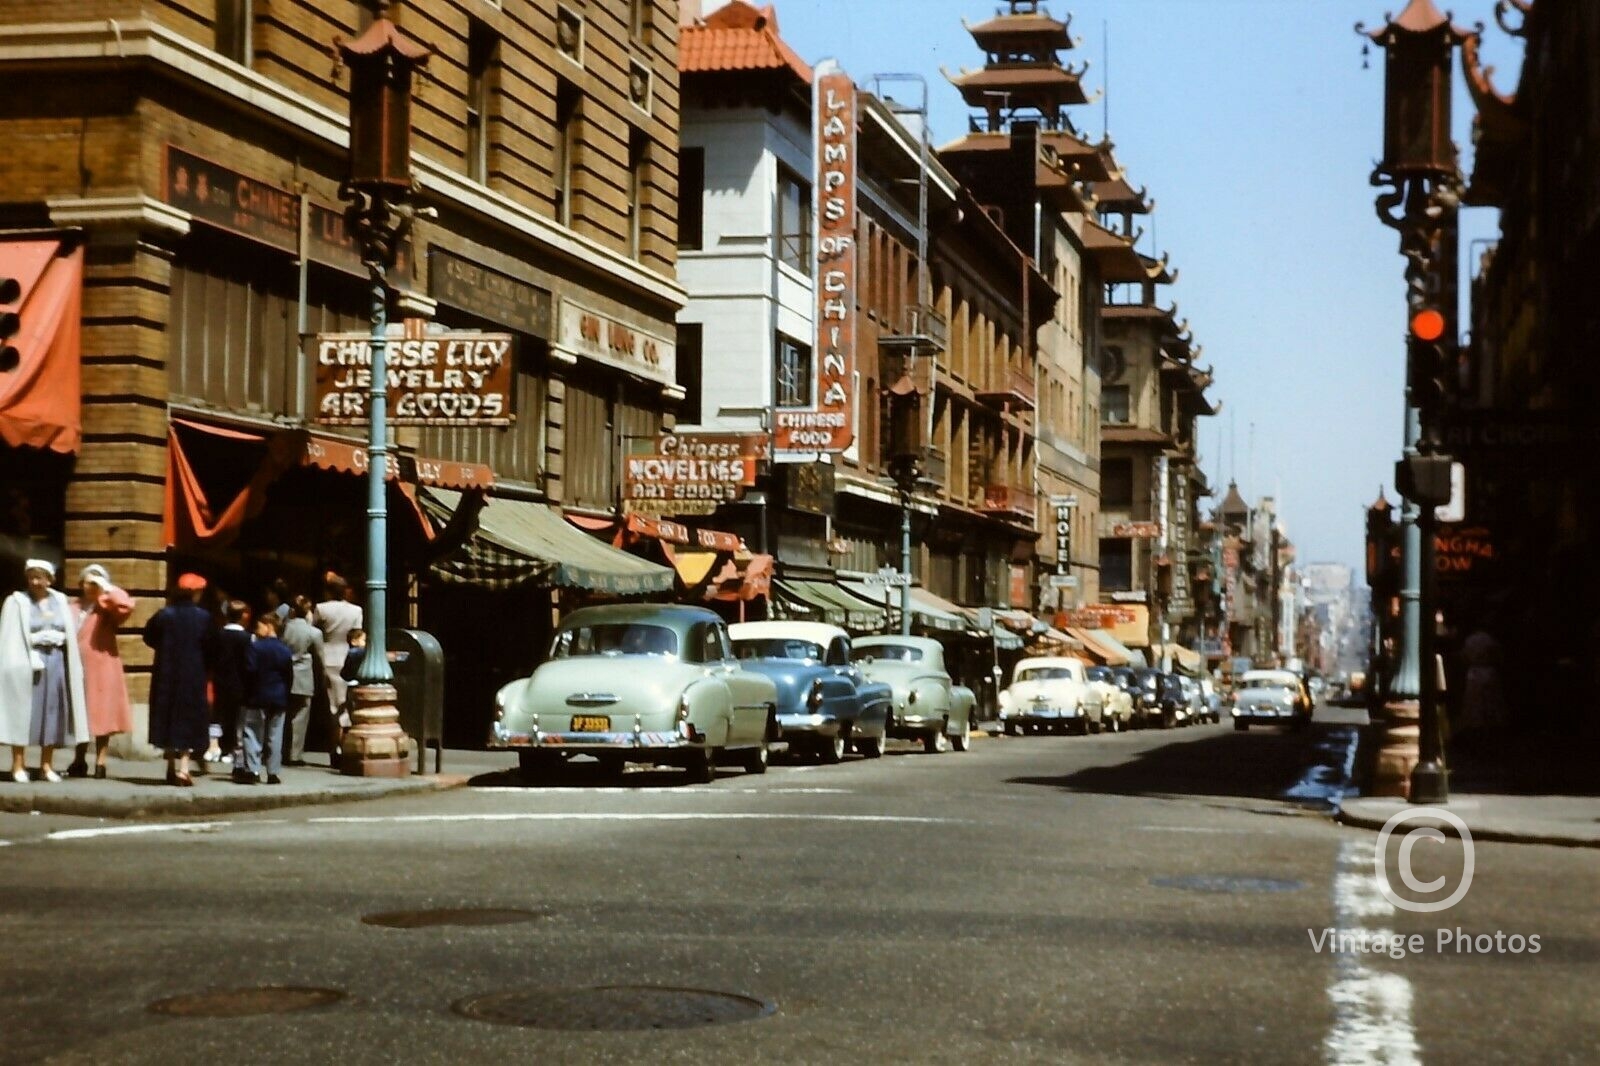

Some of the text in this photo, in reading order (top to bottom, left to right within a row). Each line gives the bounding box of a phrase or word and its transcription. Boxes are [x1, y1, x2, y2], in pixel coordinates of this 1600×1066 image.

[824, 88, 847, 222] LAMPS
[820, 235, 851, 256] OF
[823, 270, 847, 406] CHINA
[318, 341, 508, 367] CHIESE LILY
[319, 392, 502, 417] AR GOODS
[778, 412, 845, 428] CHINESE
[790, 430, 832, 446] FOOD
[632, 483, 736, 499] ART GOODS
[1057, 506, 1070, 575] HOTEL
